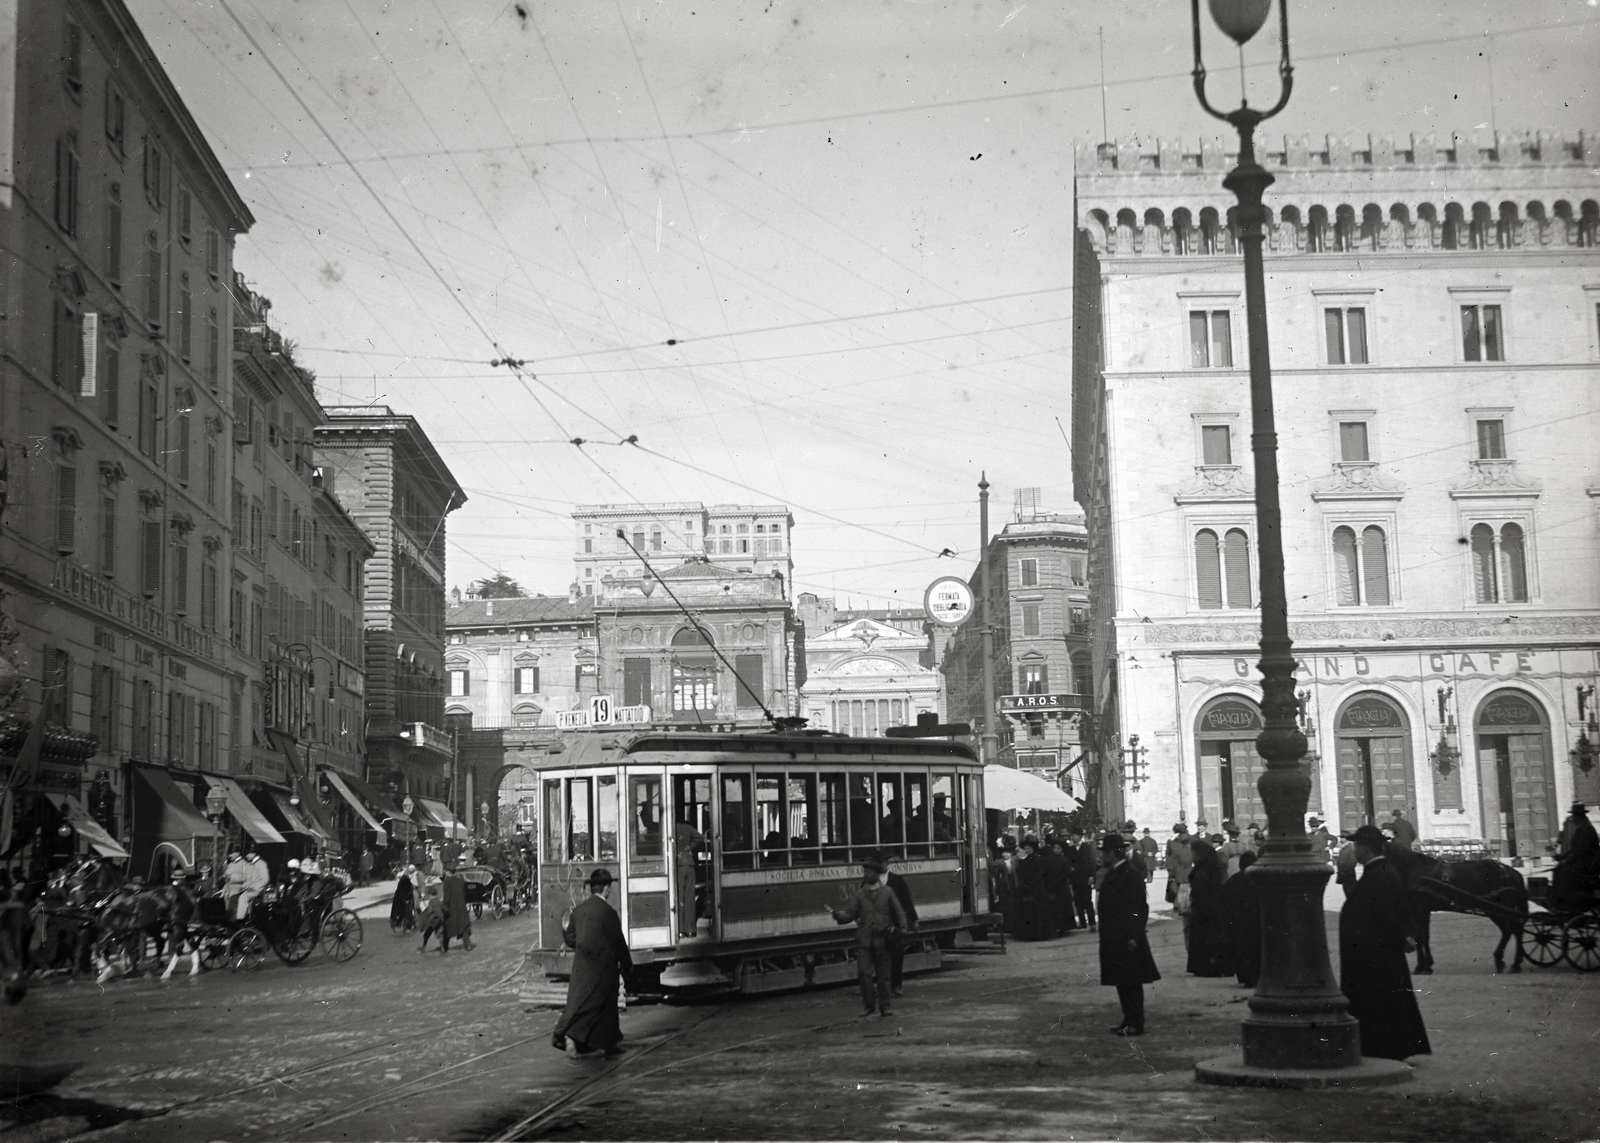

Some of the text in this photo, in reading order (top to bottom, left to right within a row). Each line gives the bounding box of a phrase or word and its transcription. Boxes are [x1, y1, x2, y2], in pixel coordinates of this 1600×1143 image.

[938, 592, 960, 601] FERMATA
[1234, 656, 1370, 678] GAND
[1017, 696, 1059, 706] A.R.O.S.
[592, 699, 608, 722] 19
[565, 711, 588, 726] VENEZIA
[809, 869, 840, 878] ROMANA
